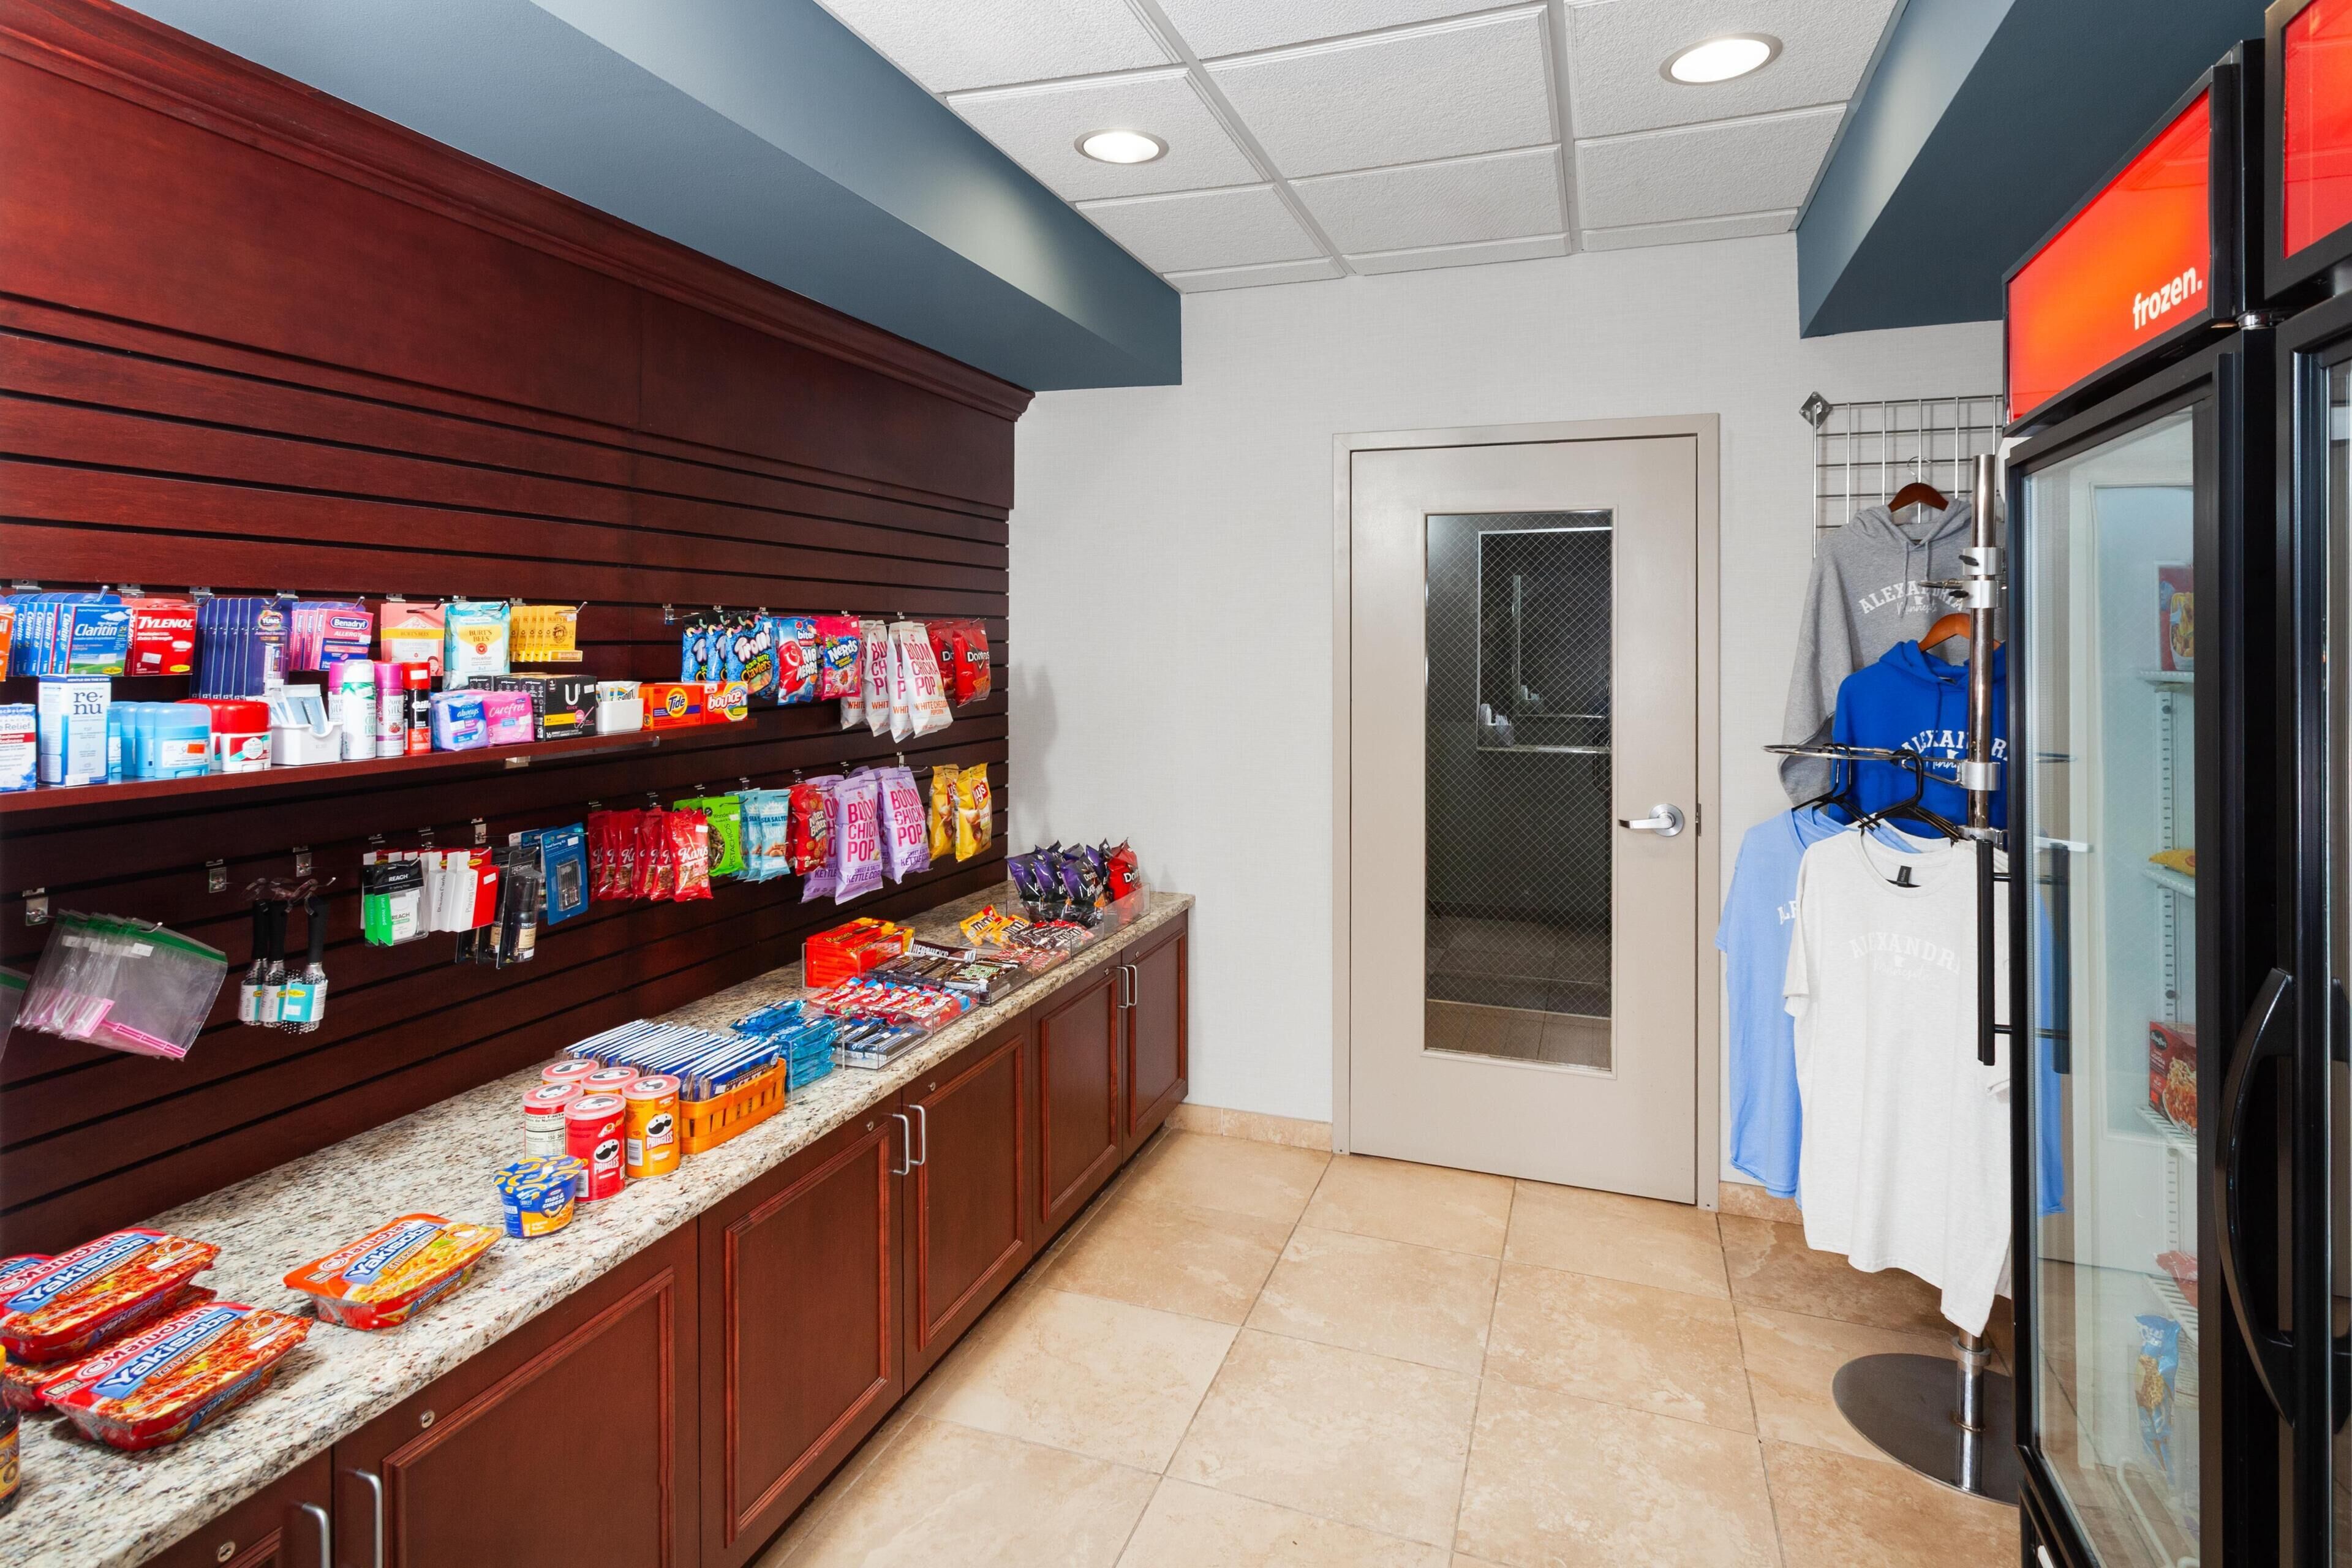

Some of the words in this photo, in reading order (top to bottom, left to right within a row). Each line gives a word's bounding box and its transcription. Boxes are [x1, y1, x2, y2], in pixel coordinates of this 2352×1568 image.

[2133, 267, 2203, 331] frozen.
[61, 613, 71, 643] Claritin
[74, 624, 118, 638] Claritin
[137, 616, 195, 630] TYLENOL
[333, 619, 366, 630] Benadryl
[734, 625, 771, 662] Trolli
[903, 642, 933, 661] BOOM
[802, 647, 817, 663] AIR
[967, 650, 990, 662] Doritos
[911, 661, 939, 676] CHICKA
[565, 684, 579, 706] U
[915, 676, 937, 697] POP
[73, 704, 103, 715] nu
[489, 703, 525, 717] Carefree
[668, 695, 685, 712] Tide
[708, 690, 743, 710] bounce
[872, 701, 889, 710] WHIT
[892, 706, 909, 714] WHIT
[915, 701, 934, 711] WHITE
[457, 707, 479, 718] always
[724, 823, 736, 867] PISTACHIOS
[897, 824, 922, 847] POP
[847, 839, 875, 862] POP
[388, 873, 409, 882] REACH
[815, 869, 837, 878] KETTLE
[846, 873, 869, 883] KETTLE
[869, 870, 881, 881] COR
[466, 892, 474, 913] Playing
[646, 1129, 674, 1150] PRINGLES
[594, 1155, 620, 1175] PRINGLES
[336, 1221, 413, 1264] Maruchan
[345, 1224, 437, 1278] Yakisoba
[387, 1247, 418, 1271] Chicken
[418, 1232, 438, 1249] Flavor
[16, 1234, 126, 1282] Maruchan
[10, 1237, 150, 1304] Yakisoba
[63, 1264, 110, 1296] Teriyaki
[103, 1308, 214, 1363] Maruchan
[97, 1312, 236, 1389] Yakisoba
[154, 1346, 200, 1378] Teriyaki
[198, 1333, 221, 1351] Beef
